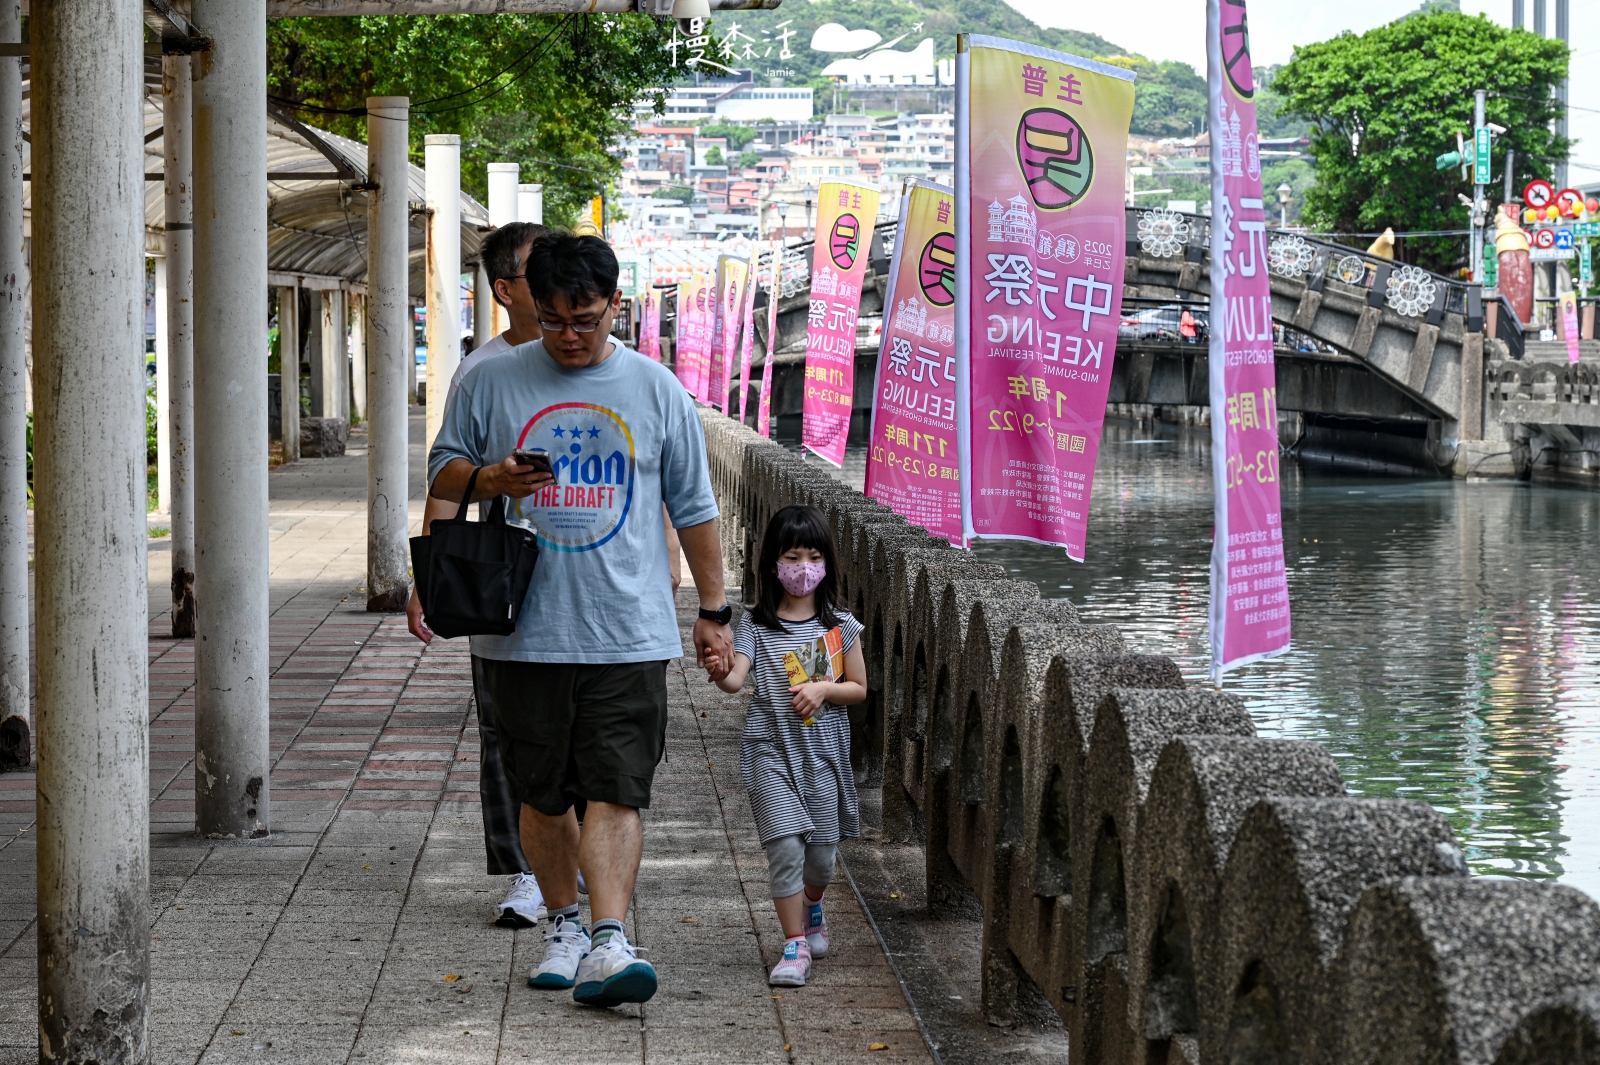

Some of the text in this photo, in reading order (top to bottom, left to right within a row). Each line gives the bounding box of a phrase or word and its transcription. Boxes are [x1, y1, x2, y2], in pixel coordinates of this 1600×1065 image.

[545, 410, 578, 421] OKINAWA
[529, 443, 626, 485] rion
[533, 485, 615, 509] THE DRAFT
